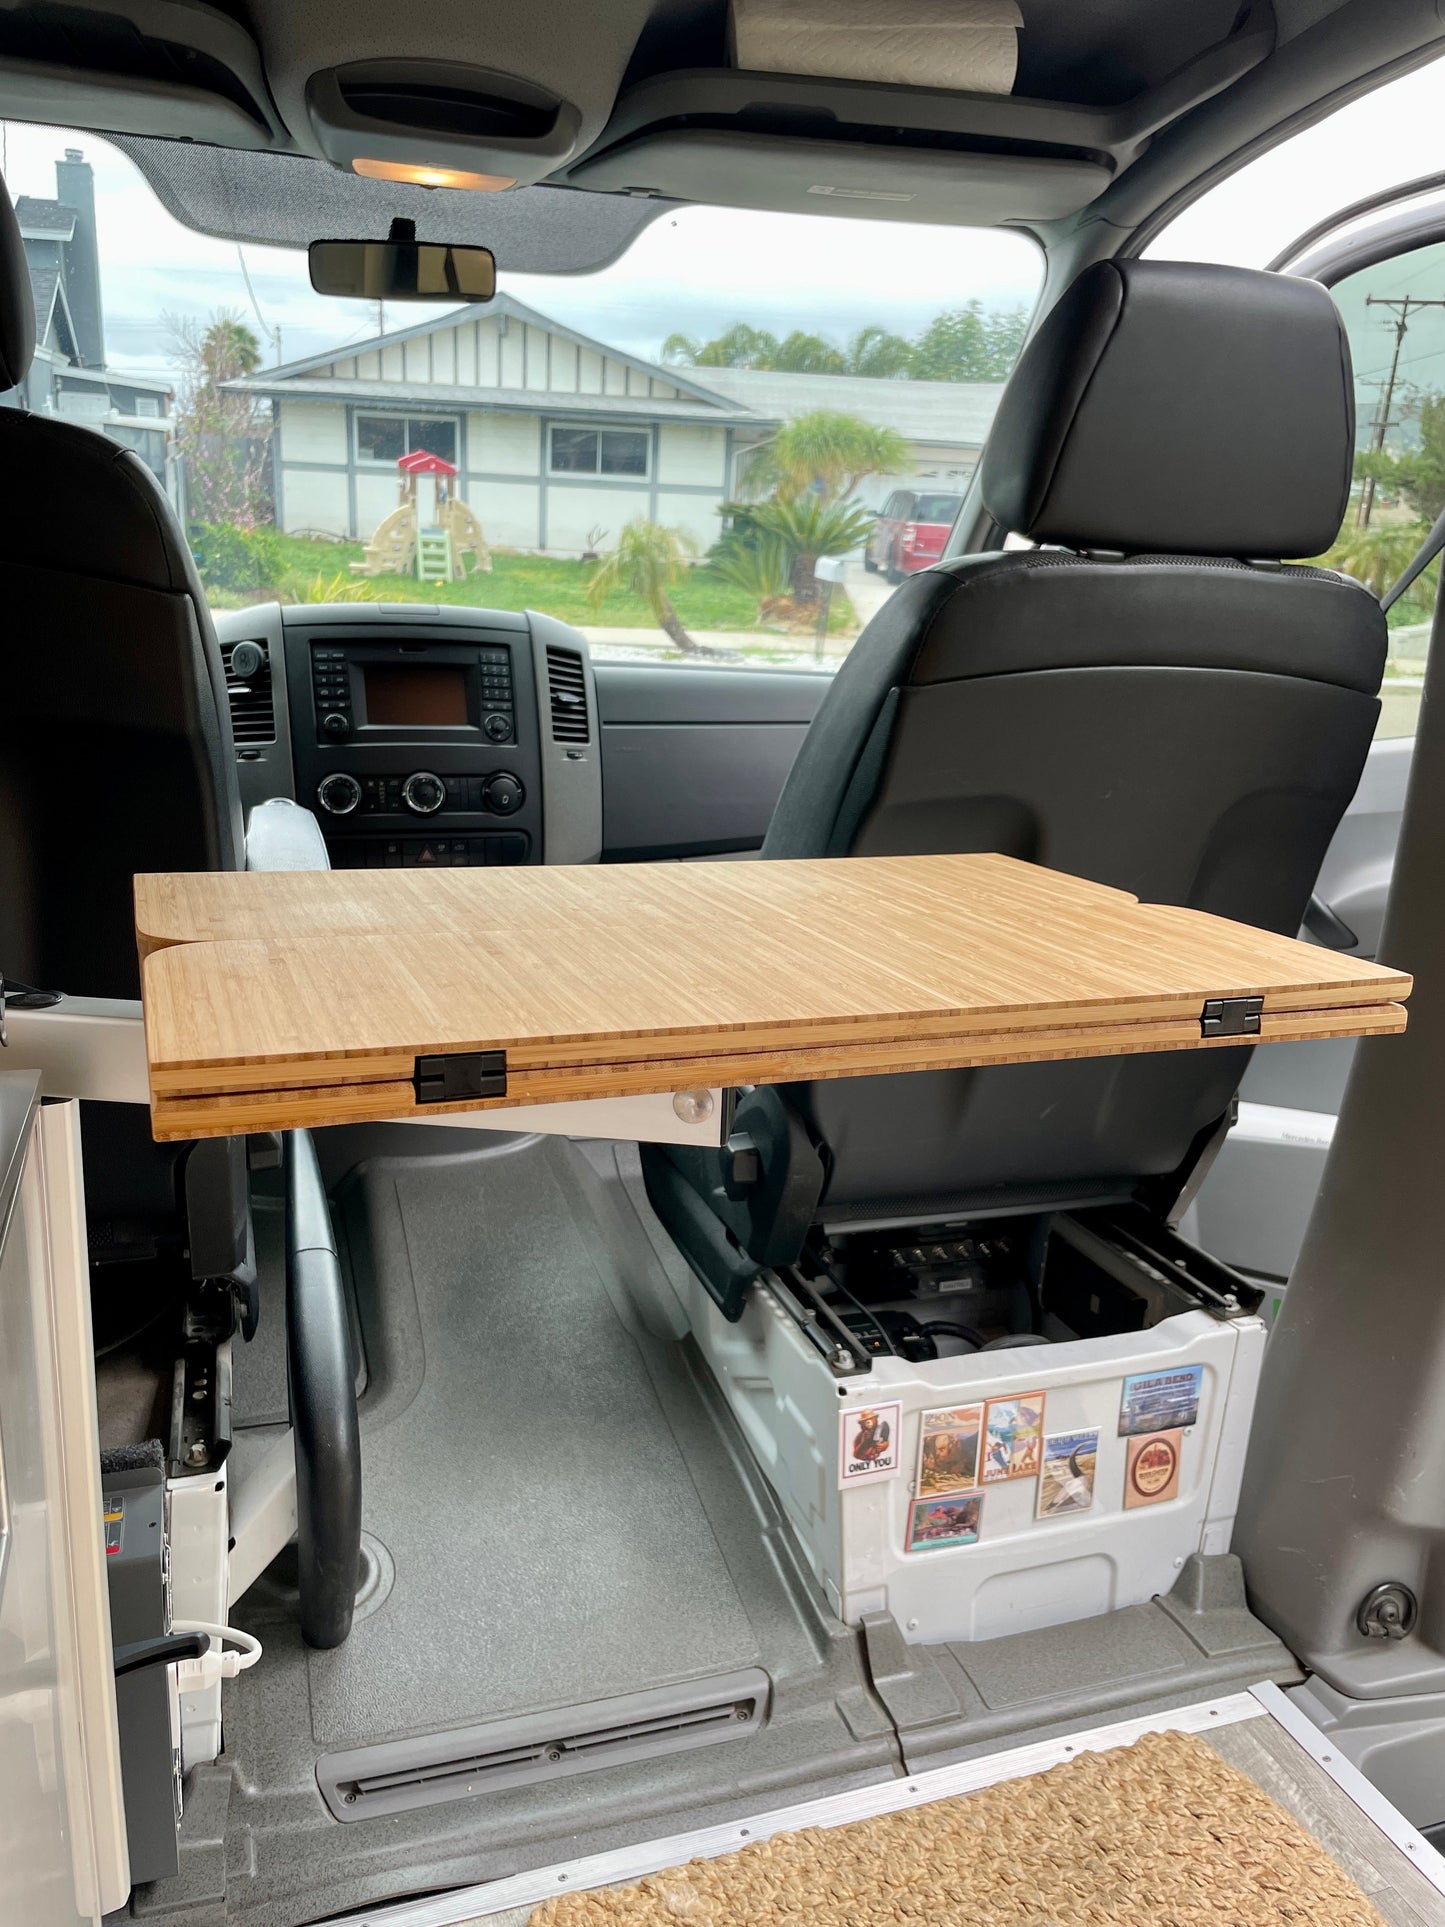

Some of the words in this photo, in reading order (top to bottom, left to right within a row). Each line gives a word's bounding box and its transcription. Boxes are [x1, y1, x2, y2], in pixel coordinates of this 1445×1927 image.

[1165, 1373, 1194, 1385] BEND
[848, 1461, 870, 1473] ONLY
[873, 1457, 892, 1468] YOU
[984, 1467, 1009, 1478] JUNE
[1011, 1461, 1037, 1473] LAKE
